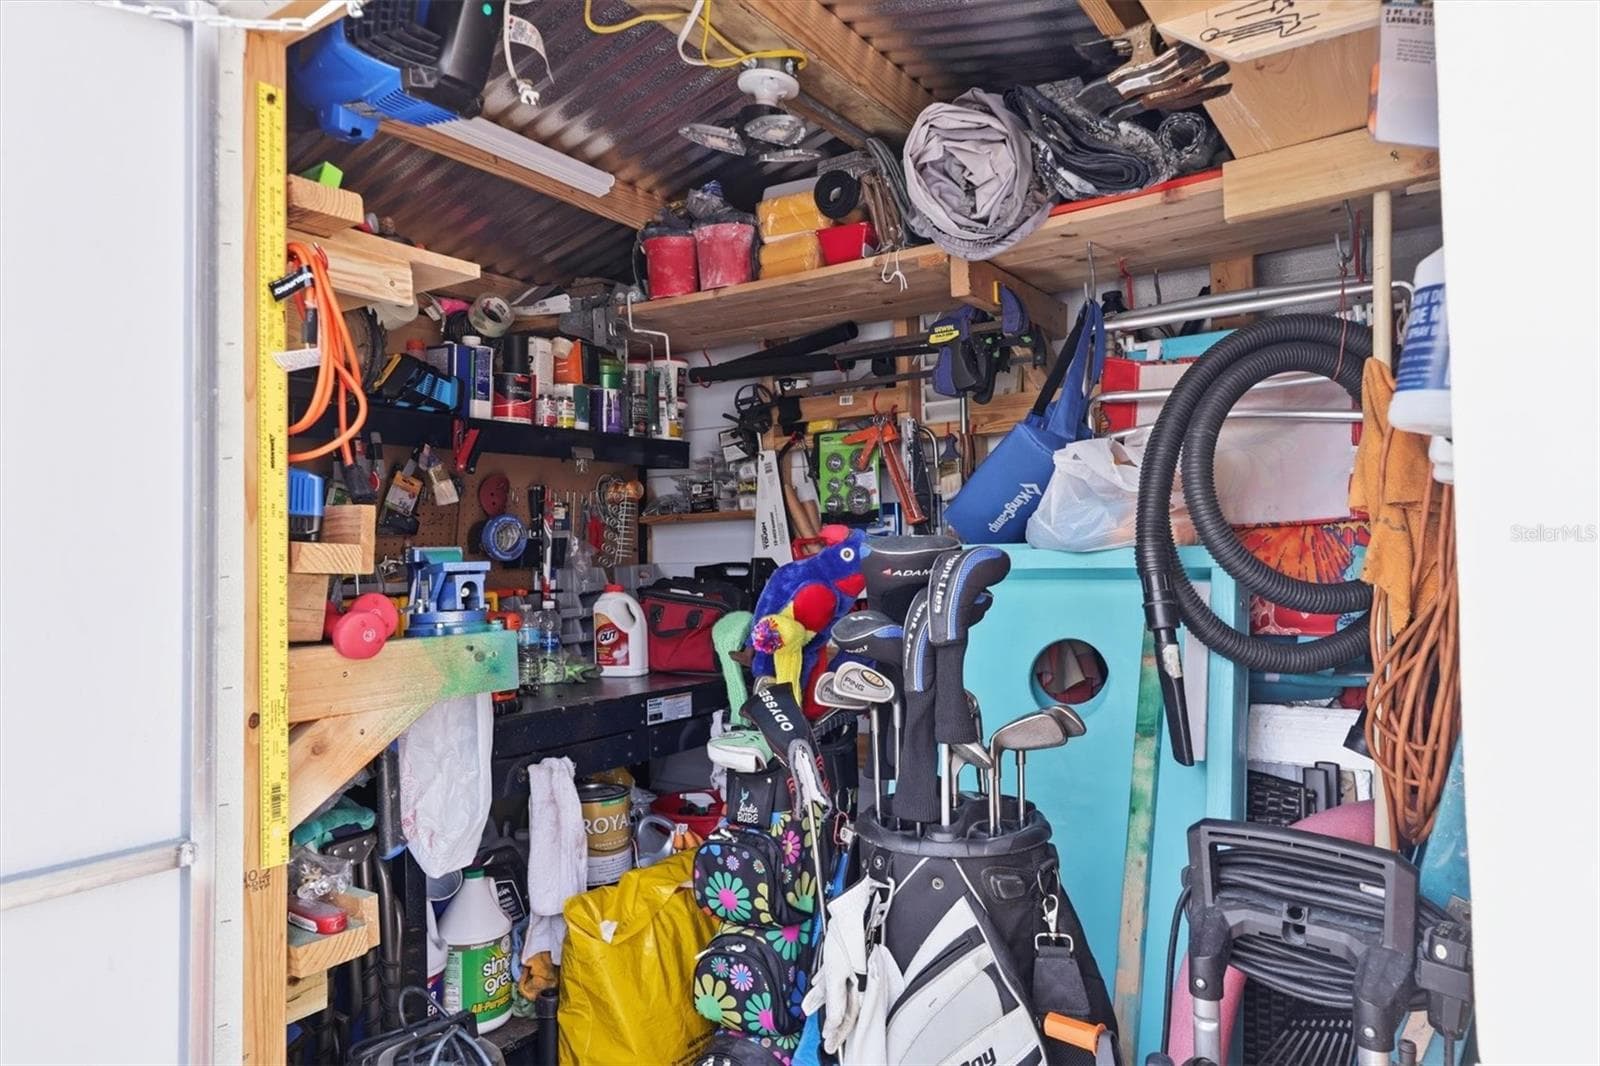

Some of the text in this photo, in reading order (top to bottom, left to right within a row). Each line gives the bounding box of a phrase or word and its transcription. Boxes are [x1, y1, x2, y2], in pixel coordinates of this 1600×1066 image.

[988, 490, 1036, 533] KingCamp
[892, 568, 932, 576] ADAM
[600, 630, 616, 642] OUT
[844, 677, 865, 692] PING
[757, 689, 795, 732] ODYSSE
[960, 1047, 997, 1066] oy
